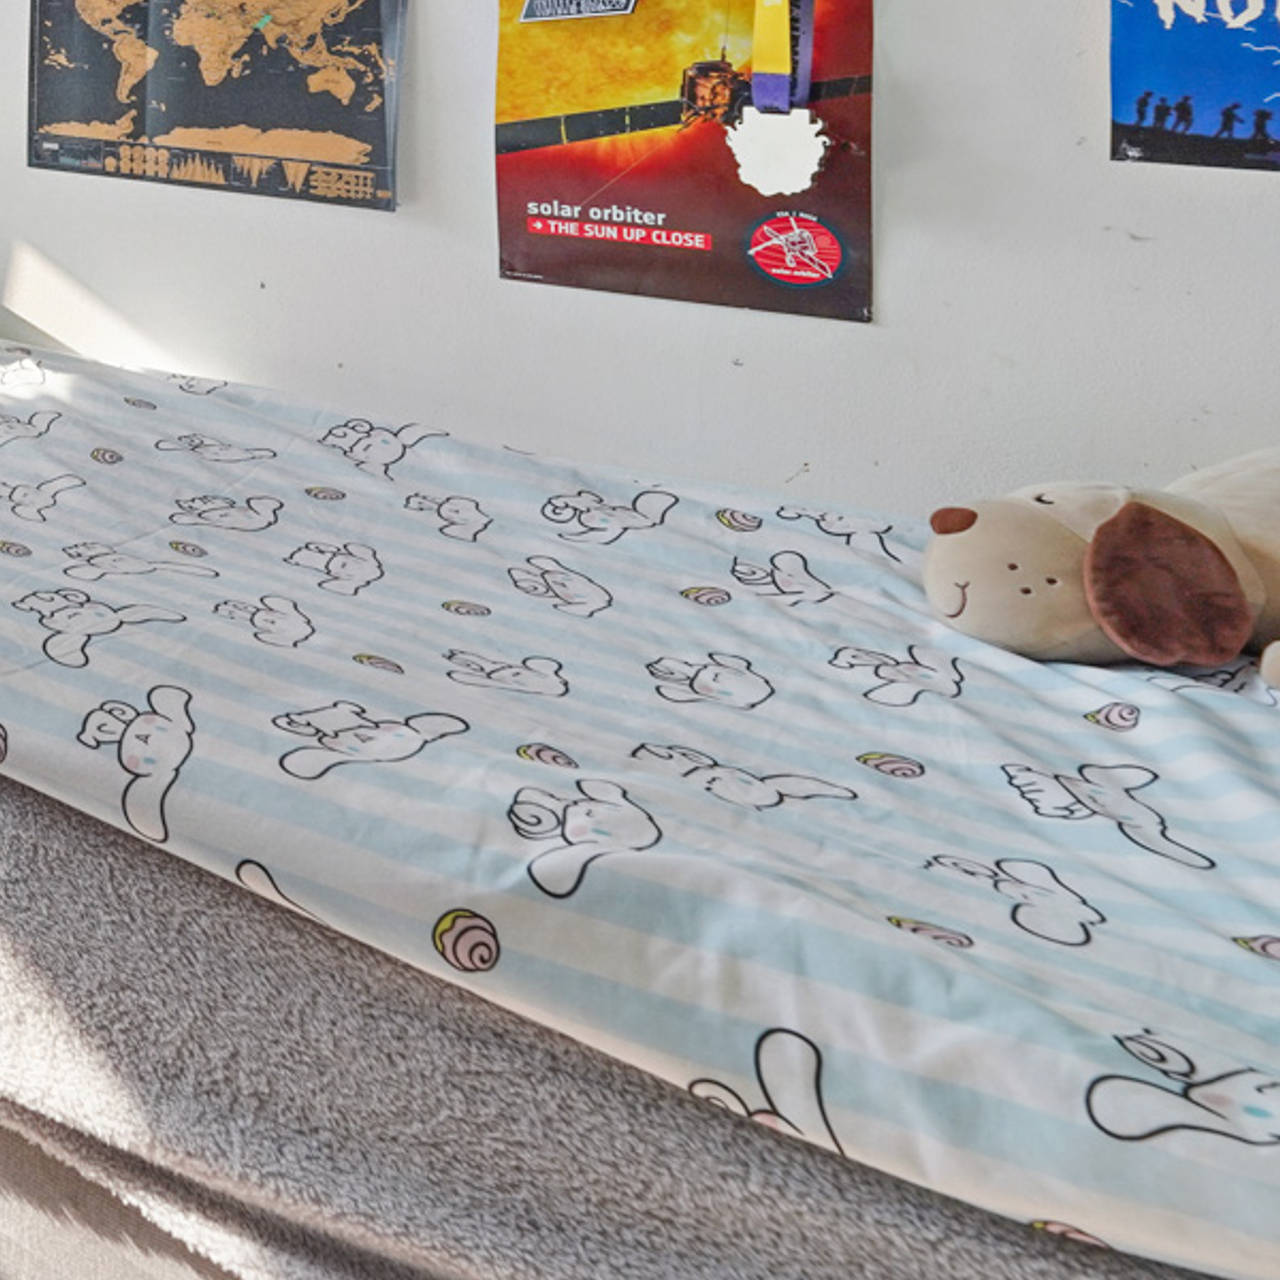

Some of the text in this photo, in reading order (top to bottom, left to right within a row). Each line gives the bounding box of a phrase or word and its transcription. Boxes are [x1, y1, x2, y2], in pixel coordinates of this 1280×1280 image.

[527, 200, 666, 225] solar orbiter
[547, 220, 706, 249] THE SUN UP CLOSE
